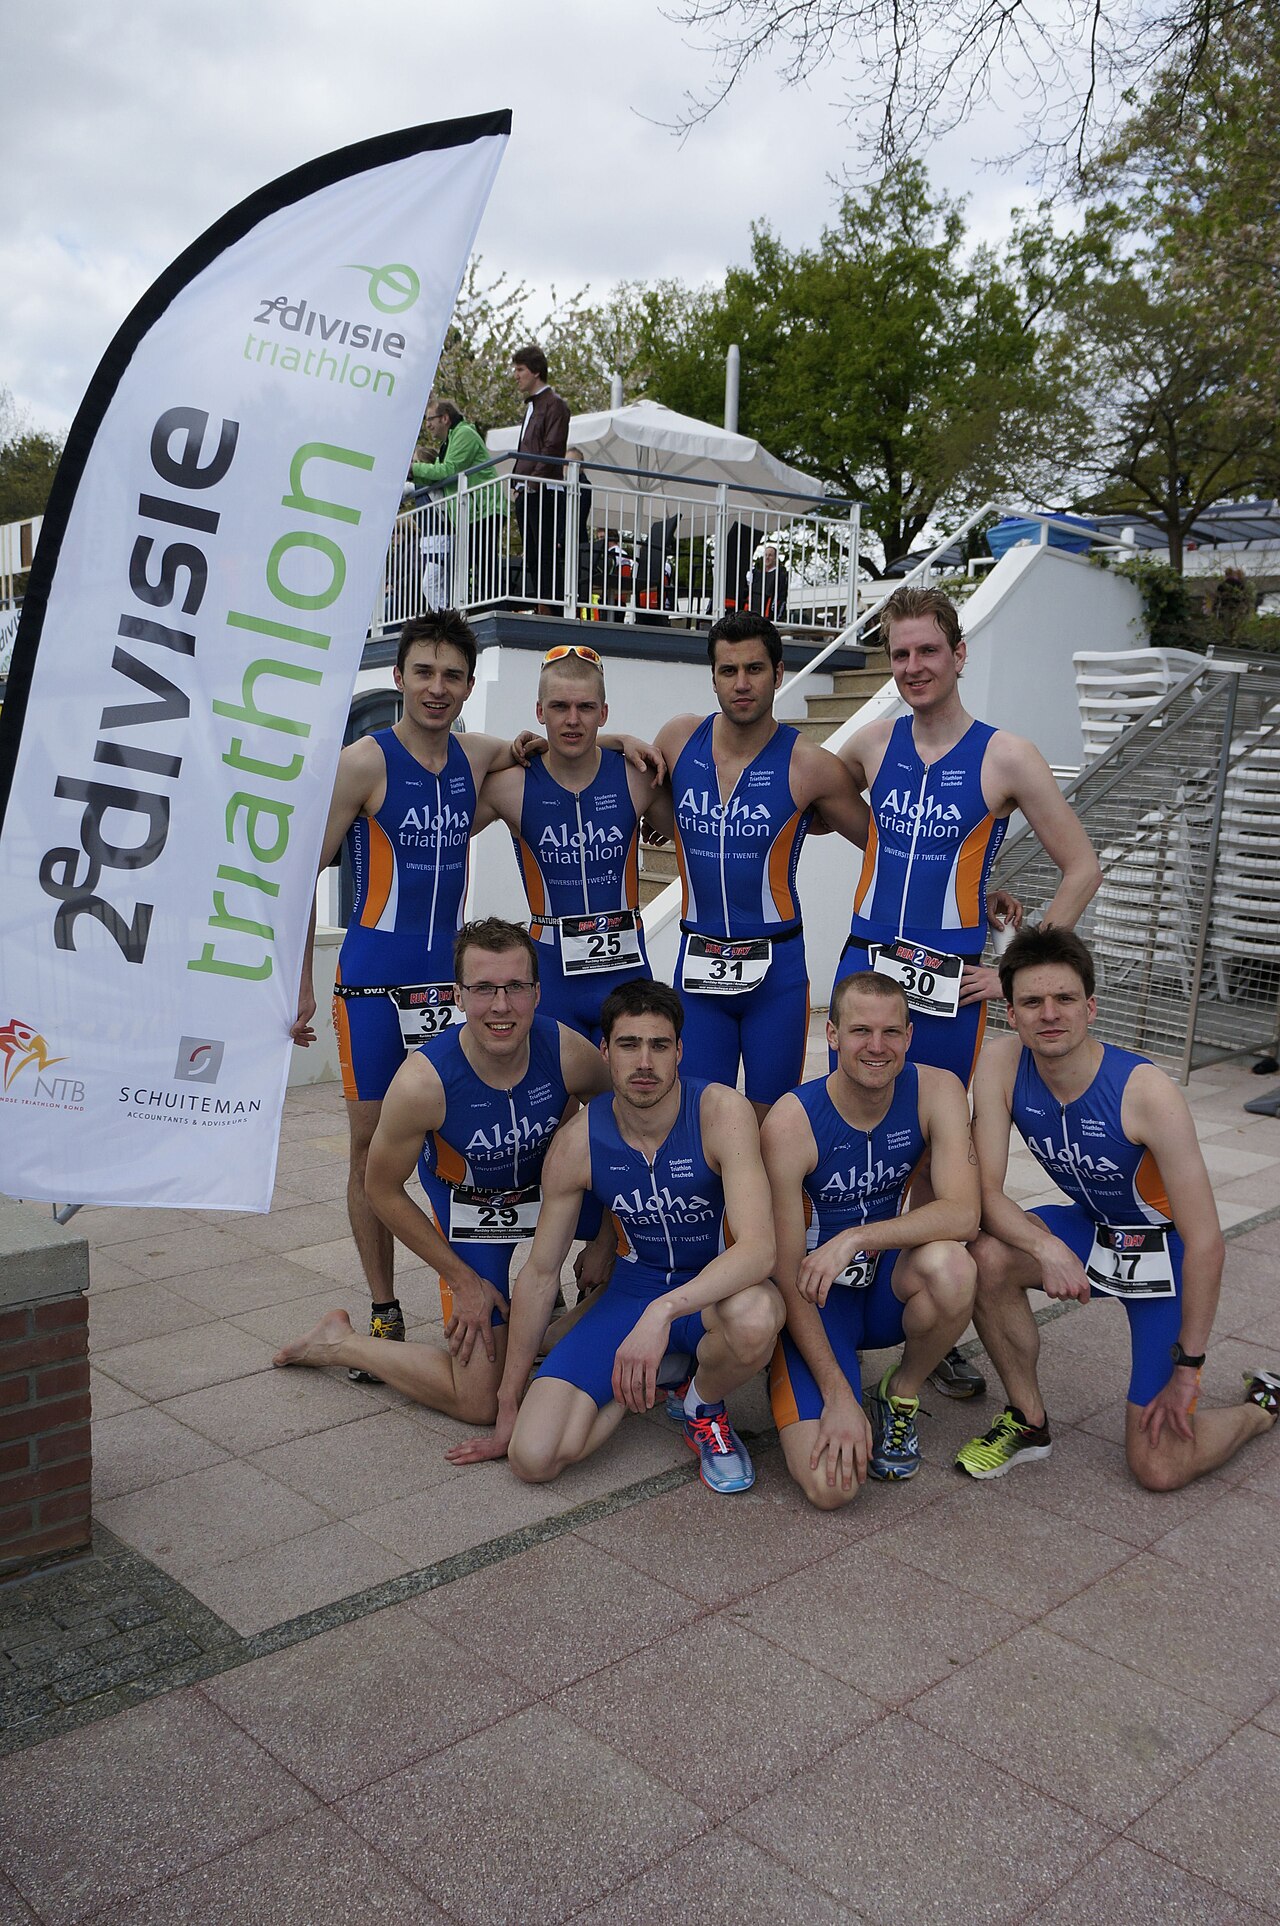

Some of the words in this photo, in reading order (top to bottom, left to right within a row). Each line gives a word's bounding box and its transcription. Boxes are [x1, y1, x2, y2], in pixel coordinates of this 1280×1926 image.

[243, 333, 396, 397] triathlon
[187, 441, 375, 981] triathlon
[594, 793, 617, 801] Studenten
[595, 804, 618, 812] Enschede
[678, 788, 772, 820] Aloha
[880, 788, 962, 821] Aloha
[398, 804, 470, 831] Aloha
[678, 812, 770, 837] triathlon
[879, 812, 960, 838] triathlon
[398, 829, 468, 848] triathlon
[538, 820, 624, 848] Aloha
[540, 844, 624, 864] triathlon
[690, 847, 730, 859] UNIVERSITIT
[884, 846, 920, 861] UNIVERSITIT
[406, 862, 445, 871] UNIVERSITIT
[587, 933, 621, 958] 25
[709, 960, 743, 980] 31
[899, 966, 936, 997] 30
[419, 1007, 453, 1032] 32
[33, 1075, 85, 1103] NTB
[118, 1086, 262, 1114] SCHUITEMAN
[527, 1082, 552, 1096] Studenten
[529, 1089, 551, 1101] Triathlon
[530, 1094, 553, 1106] Enschede
[21, 1099, 61, 1109] TRIATHLON
[63, 1104, 85, 1112] BOND
[127, 1111, 189, 1125] ACCOUNTANTS
[201, 1117, 248, 1127] ADVISEURS
[465, 1116, 560, 1150] Aloha
[886, 1128, 912, 1139] Studenten
[887, 1135, 910, 1145] Triathlon
[465, 1136, 552, 1162] triathlo
[888, 1141, 912, 1151] Enschede
[1027, 1136, 1120, 1172] Aloha
[820, 1160, 912, 1192] Aloha
[1038, 1158, 1125, 1182] riathlon
[611, 1187, 711, 1214] Aloha
[819, 1175, 909, 1202] triathlon
[477, 1208, 519, 1226] 29
[633, 1232, 678, 1242] UNIVERSITIT
[1109, 1230, 1146, 1251] 2DAY
[1112, 1253, 1142, 1280] 27
